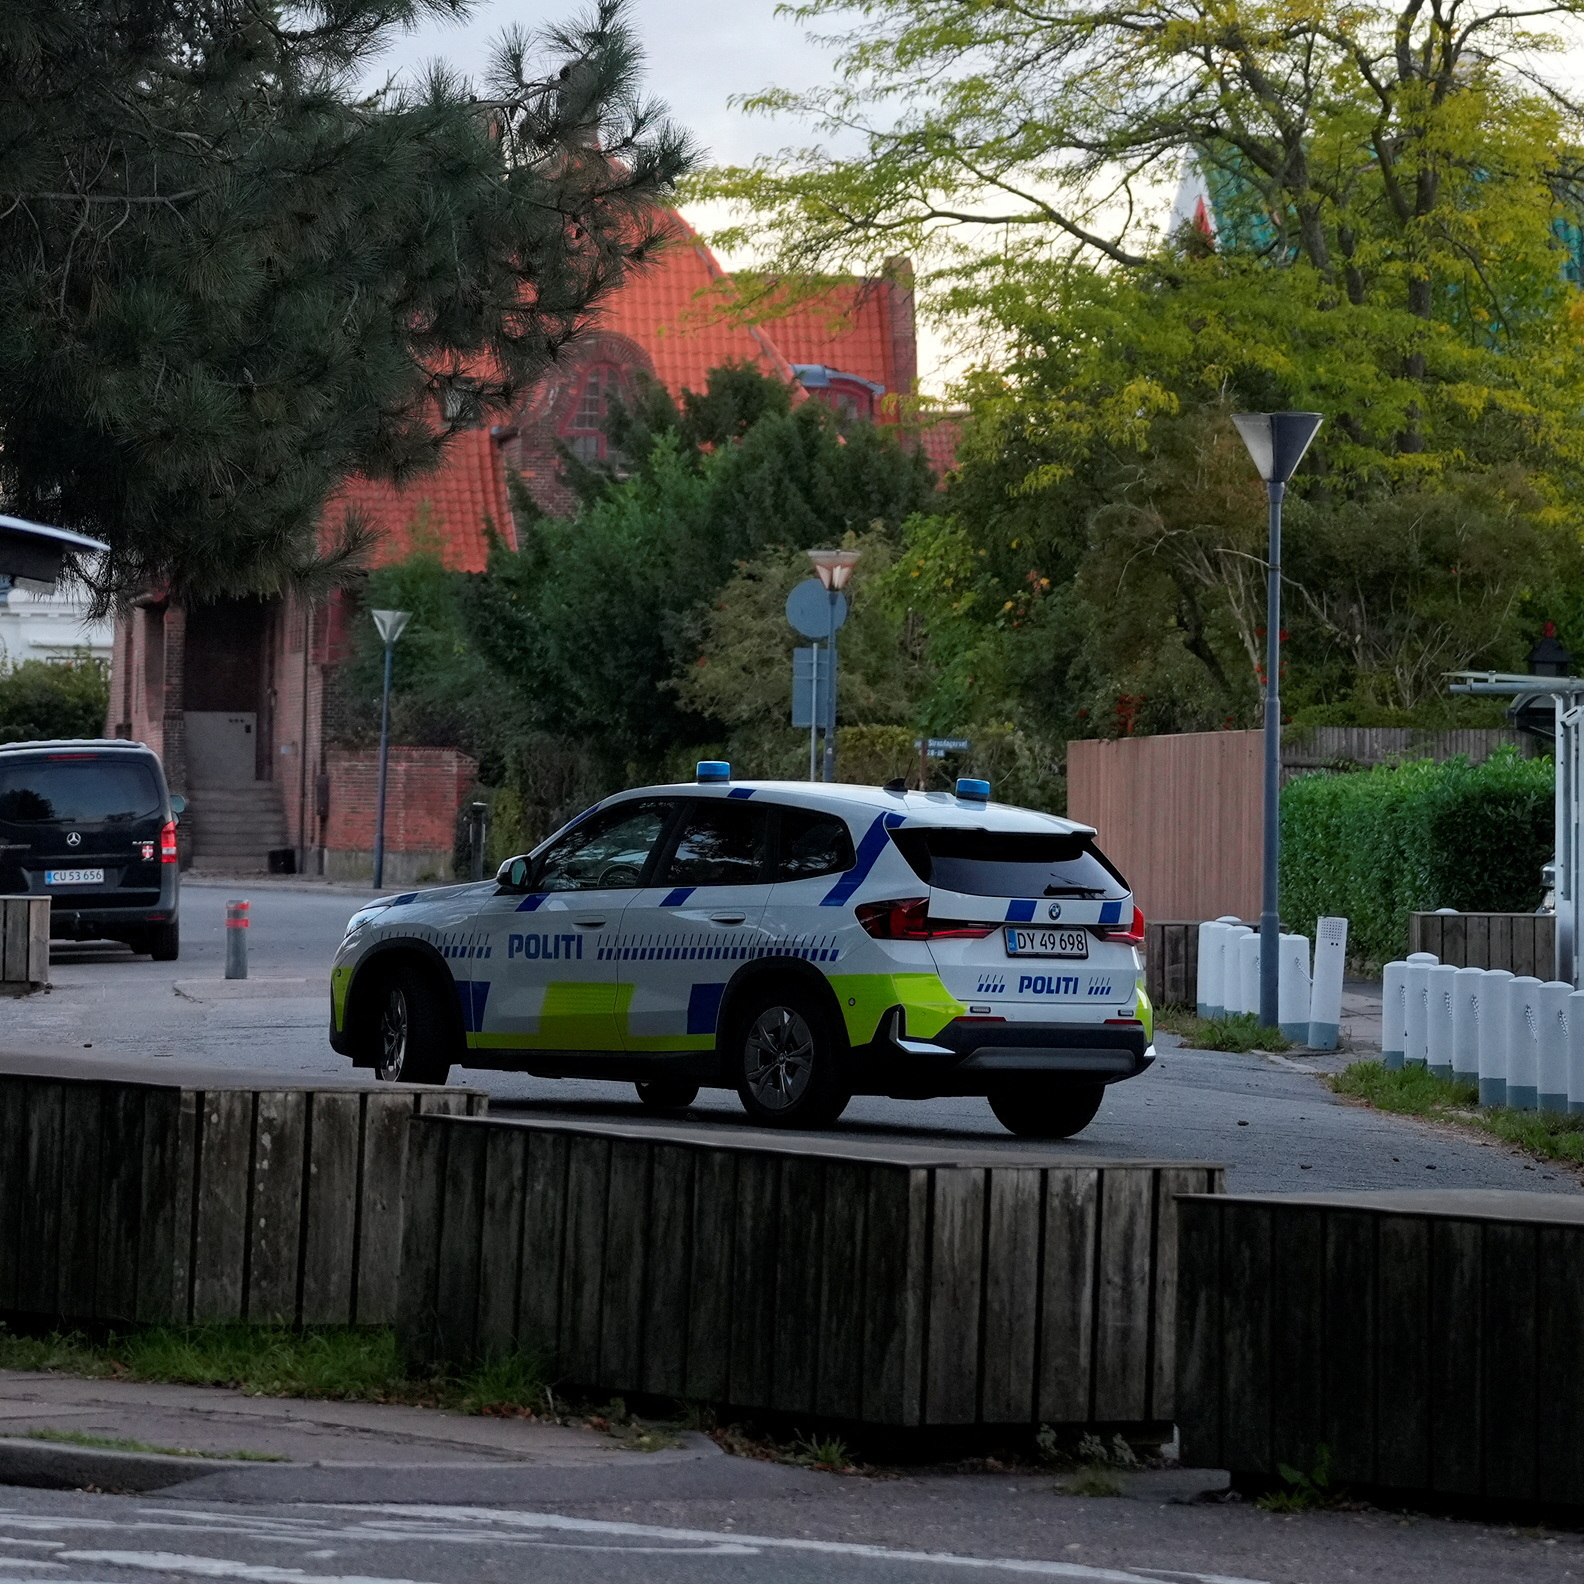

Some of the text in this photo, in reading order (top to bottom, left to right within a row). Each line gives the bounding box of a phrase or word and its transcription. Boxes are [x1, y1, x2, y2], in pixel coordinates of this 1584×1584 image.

[52, 870, 102, 882] CU 53 656
[508, 933, 583, 960] POLITI
[1017, 932, 1085, 952] DY 49 698
[1018, 975, 1079, 995] POLITI
